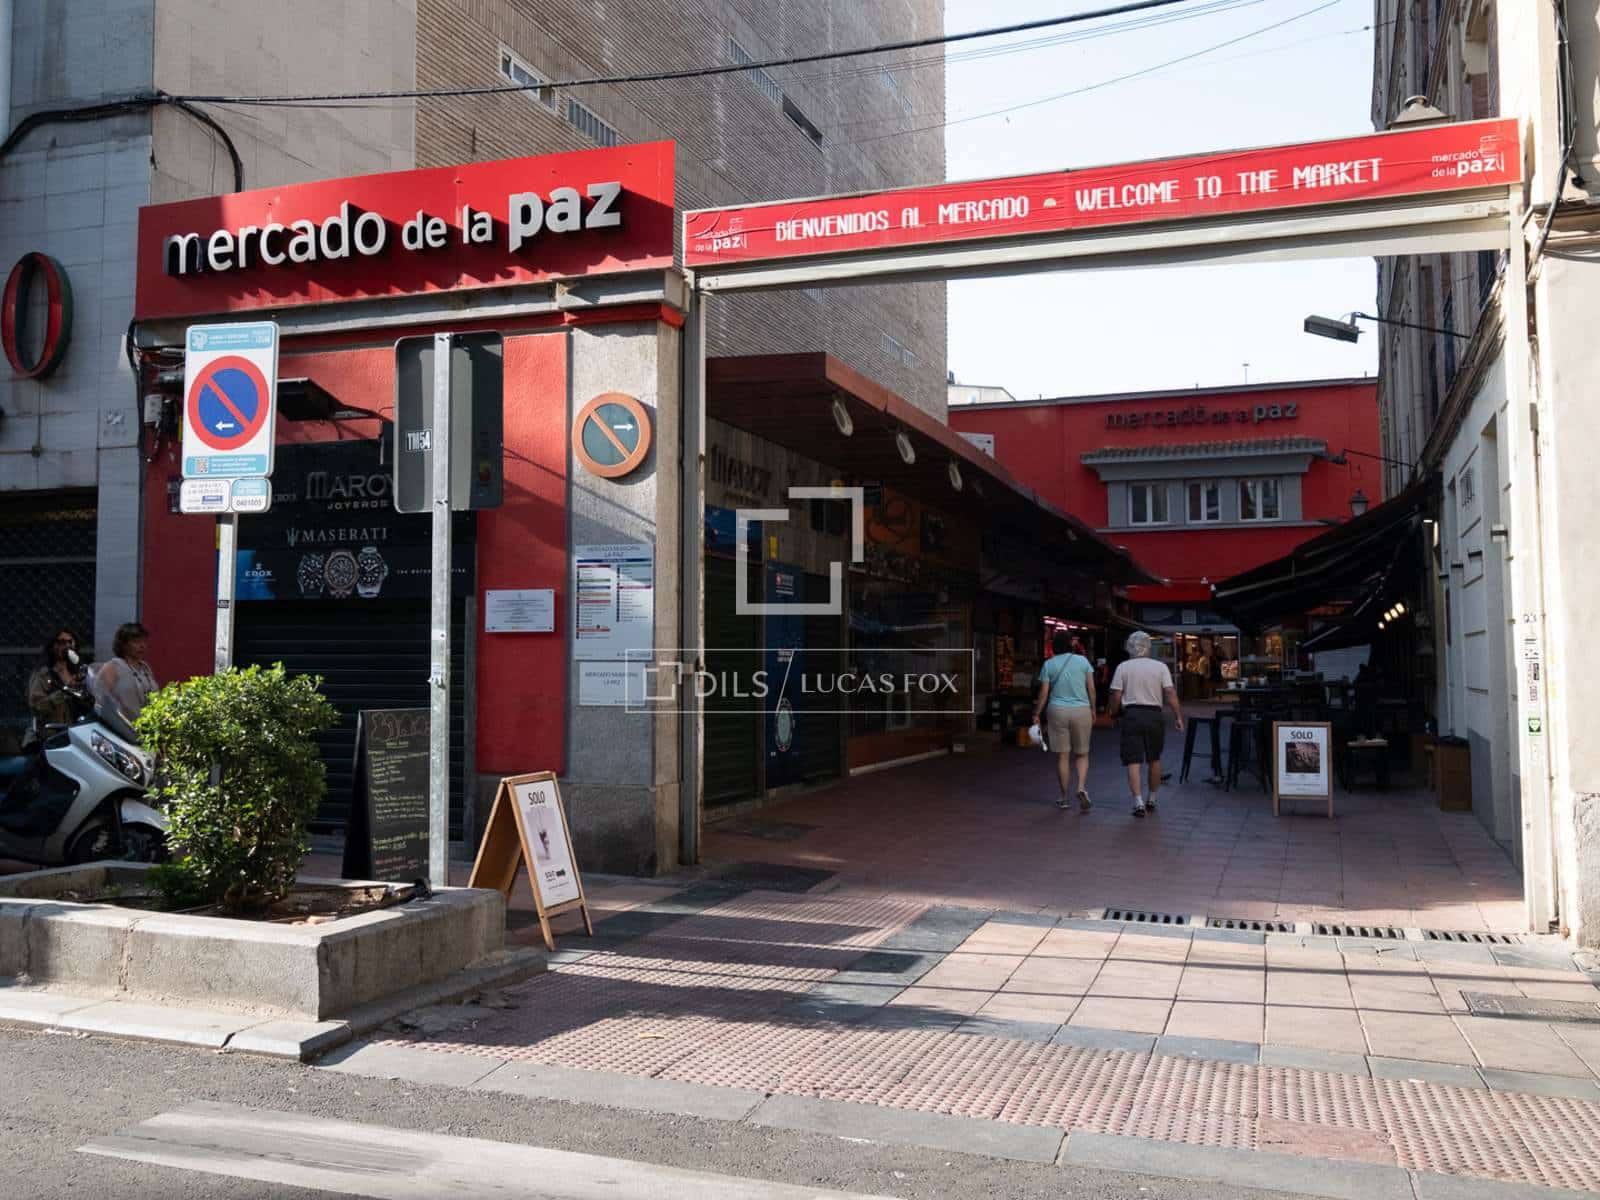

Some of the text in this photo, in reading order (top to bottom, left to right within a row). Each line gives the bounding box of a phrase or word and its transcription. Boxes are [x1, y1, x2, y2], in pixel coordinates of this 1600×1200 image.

[1431, 150, 1479, 162] mercado
[1431, 157, 1496, 178] de la paz
[775, 157, 1384, 242] BIENVENIDOS AL MERCADO WELCOME TO THE MARKET
[164, 181, 623, 277] mercado de la paz
[713, 236, 741, 253] paz
[1105, 404, 1206, 427] mercado
[1252, 401, 1298, 424] paz
[303, 527, 388, 543] MASERATI
[1290, 730, 1314, 740] SOLO
[527, 790, 546, 806] SOLO
